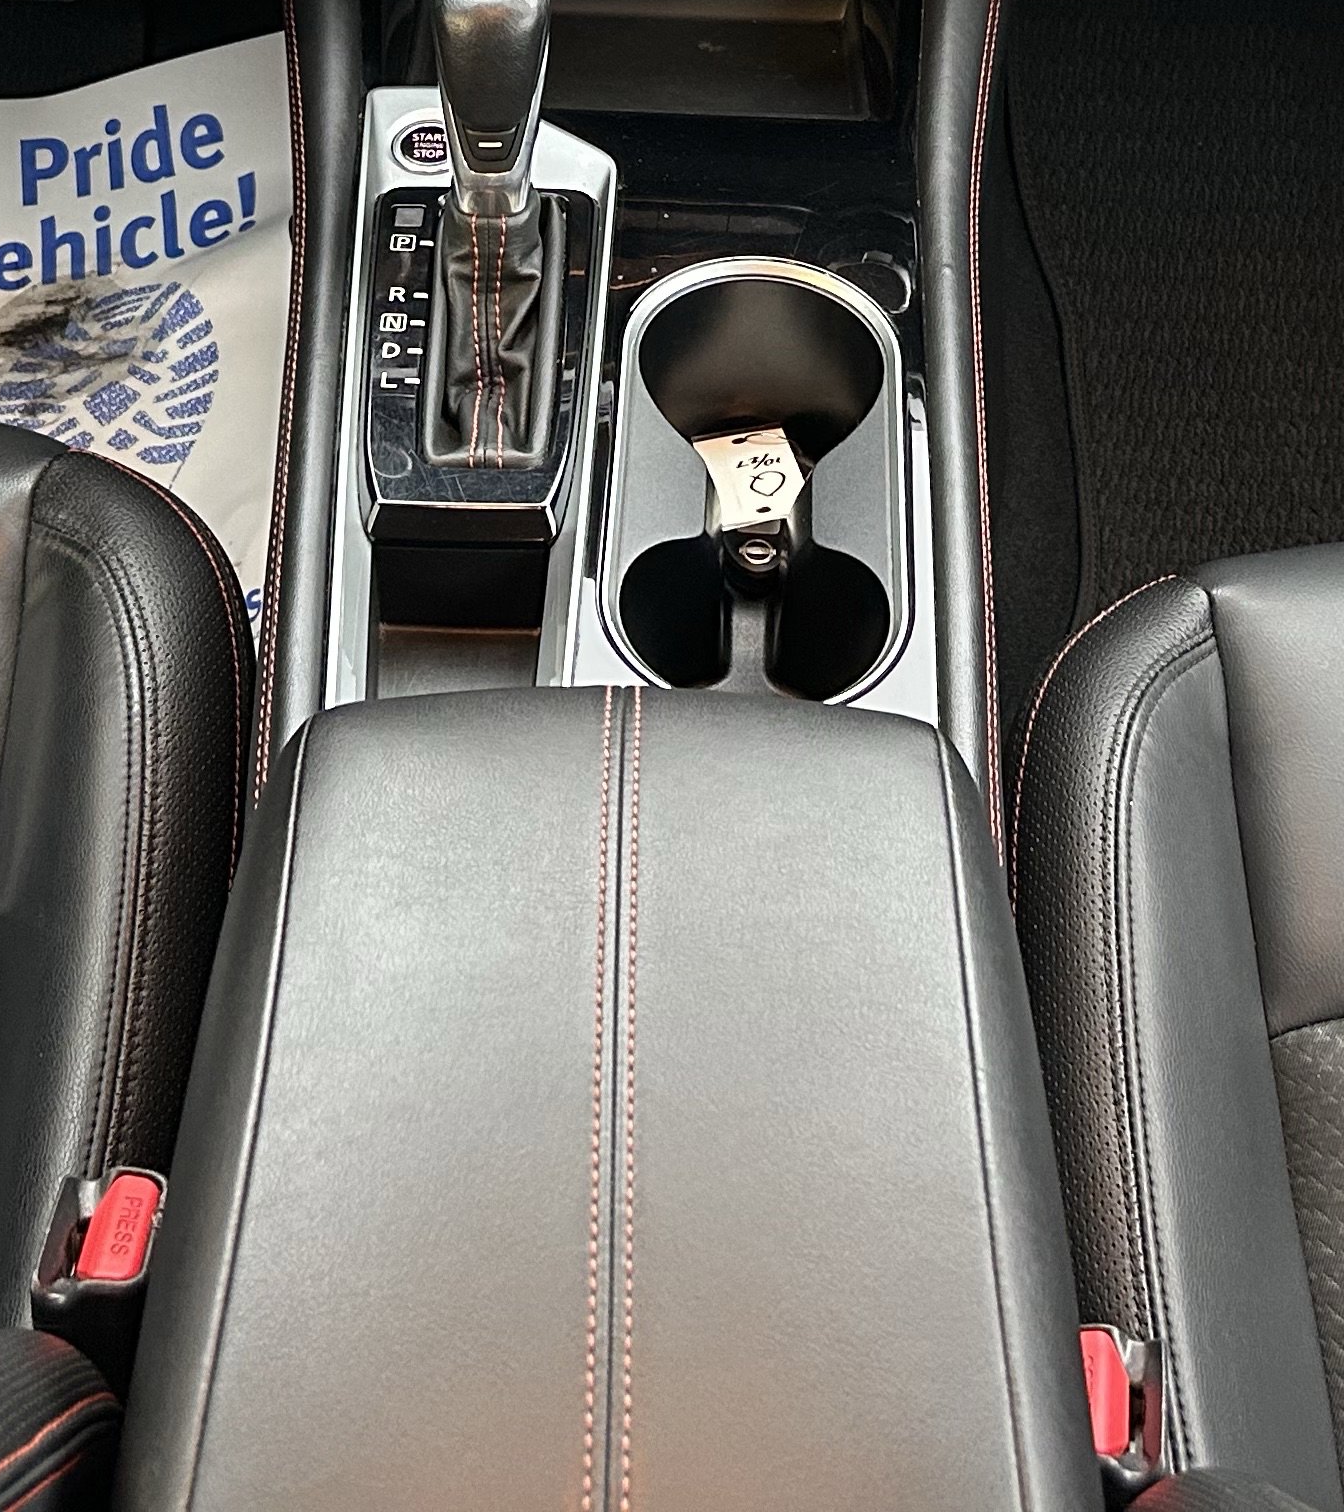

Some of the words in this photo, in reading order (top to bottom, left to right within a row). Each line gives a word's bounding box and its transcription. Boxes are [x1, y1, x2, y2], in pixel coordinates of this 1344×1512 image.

[19, 103, 225, 207] Pride
[413, 149, 444, 158] STOP
[388, 287, 406, 303] R
[381, 342, 401, 359] D
[380, 371, 398, 388] L
[110, 1195, 144, 1257] PRESS
